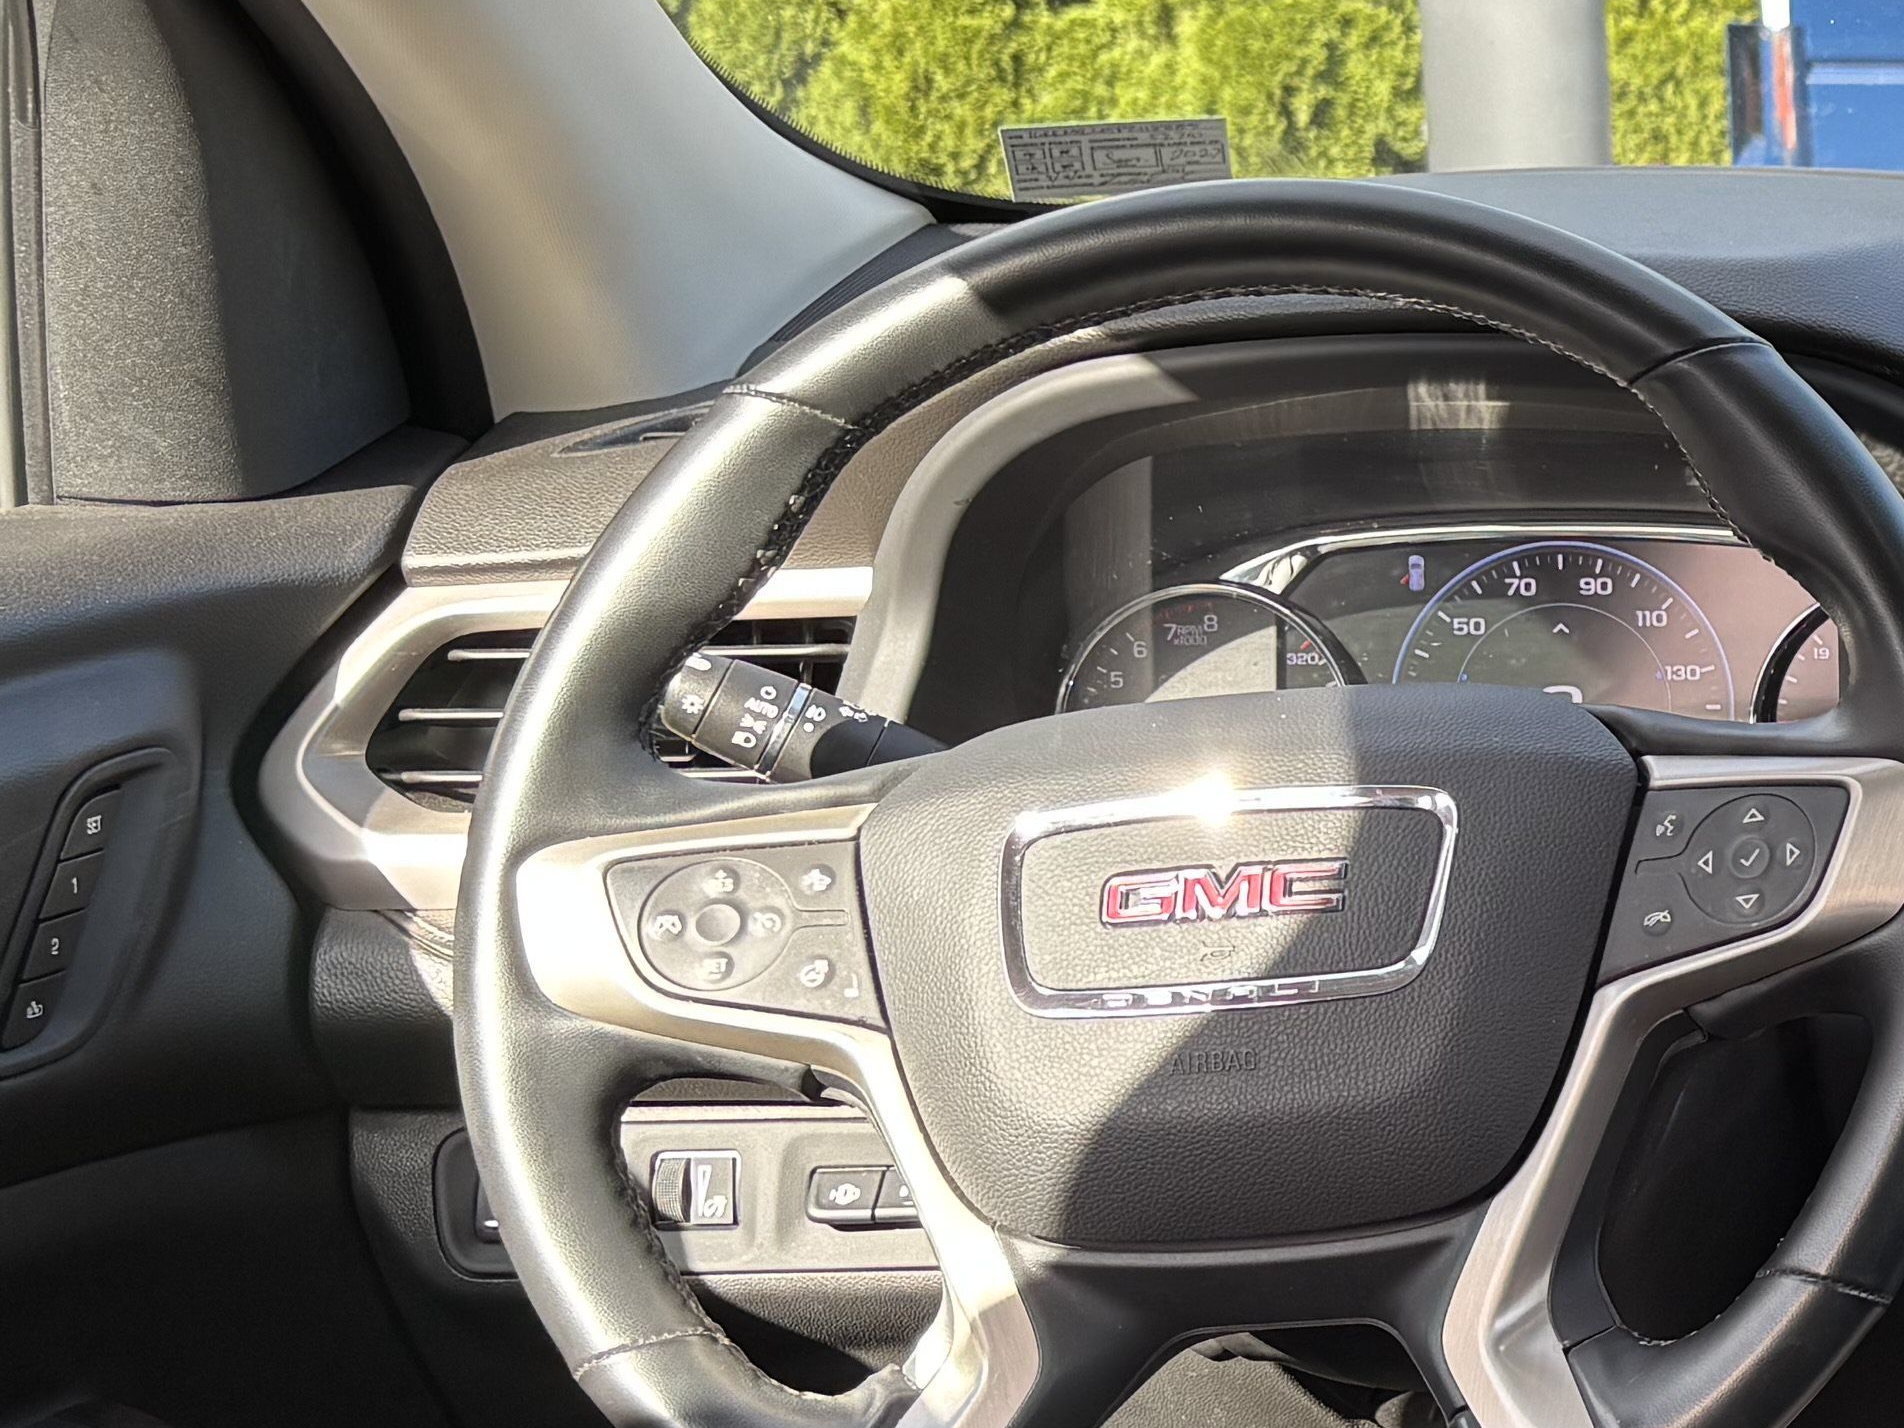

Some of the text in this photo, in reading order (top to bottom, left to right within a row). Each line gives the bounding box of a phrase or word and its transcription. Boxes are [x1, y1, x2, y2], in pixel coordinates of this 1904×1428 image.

[1504, 577, 1537, 597] 70
[1578, 576, 1613, 596] 90
[1203, 614, 1218, 632] 8
[1452, 617, 1486, 636] 50
[1635, 610, 1668, 628] 110
[1163, 624, 1178, 642] 7
[1132, 641, 1148, 658] 6
[1286, 652, 1318, 665] 320
[1812, 647, 1830, 661] 19
[1109, 671, 1124, 689] 5
[1664, 664, 1700, 682] 130
[743, 696, 779, 719] AUTO
[71, 876, 79, 894] 1
[1101, 856, 1349, 928] GMC
[51, 938, 59, 955] 2
[1169, 1048, 1259, 1075] AIRBAG
